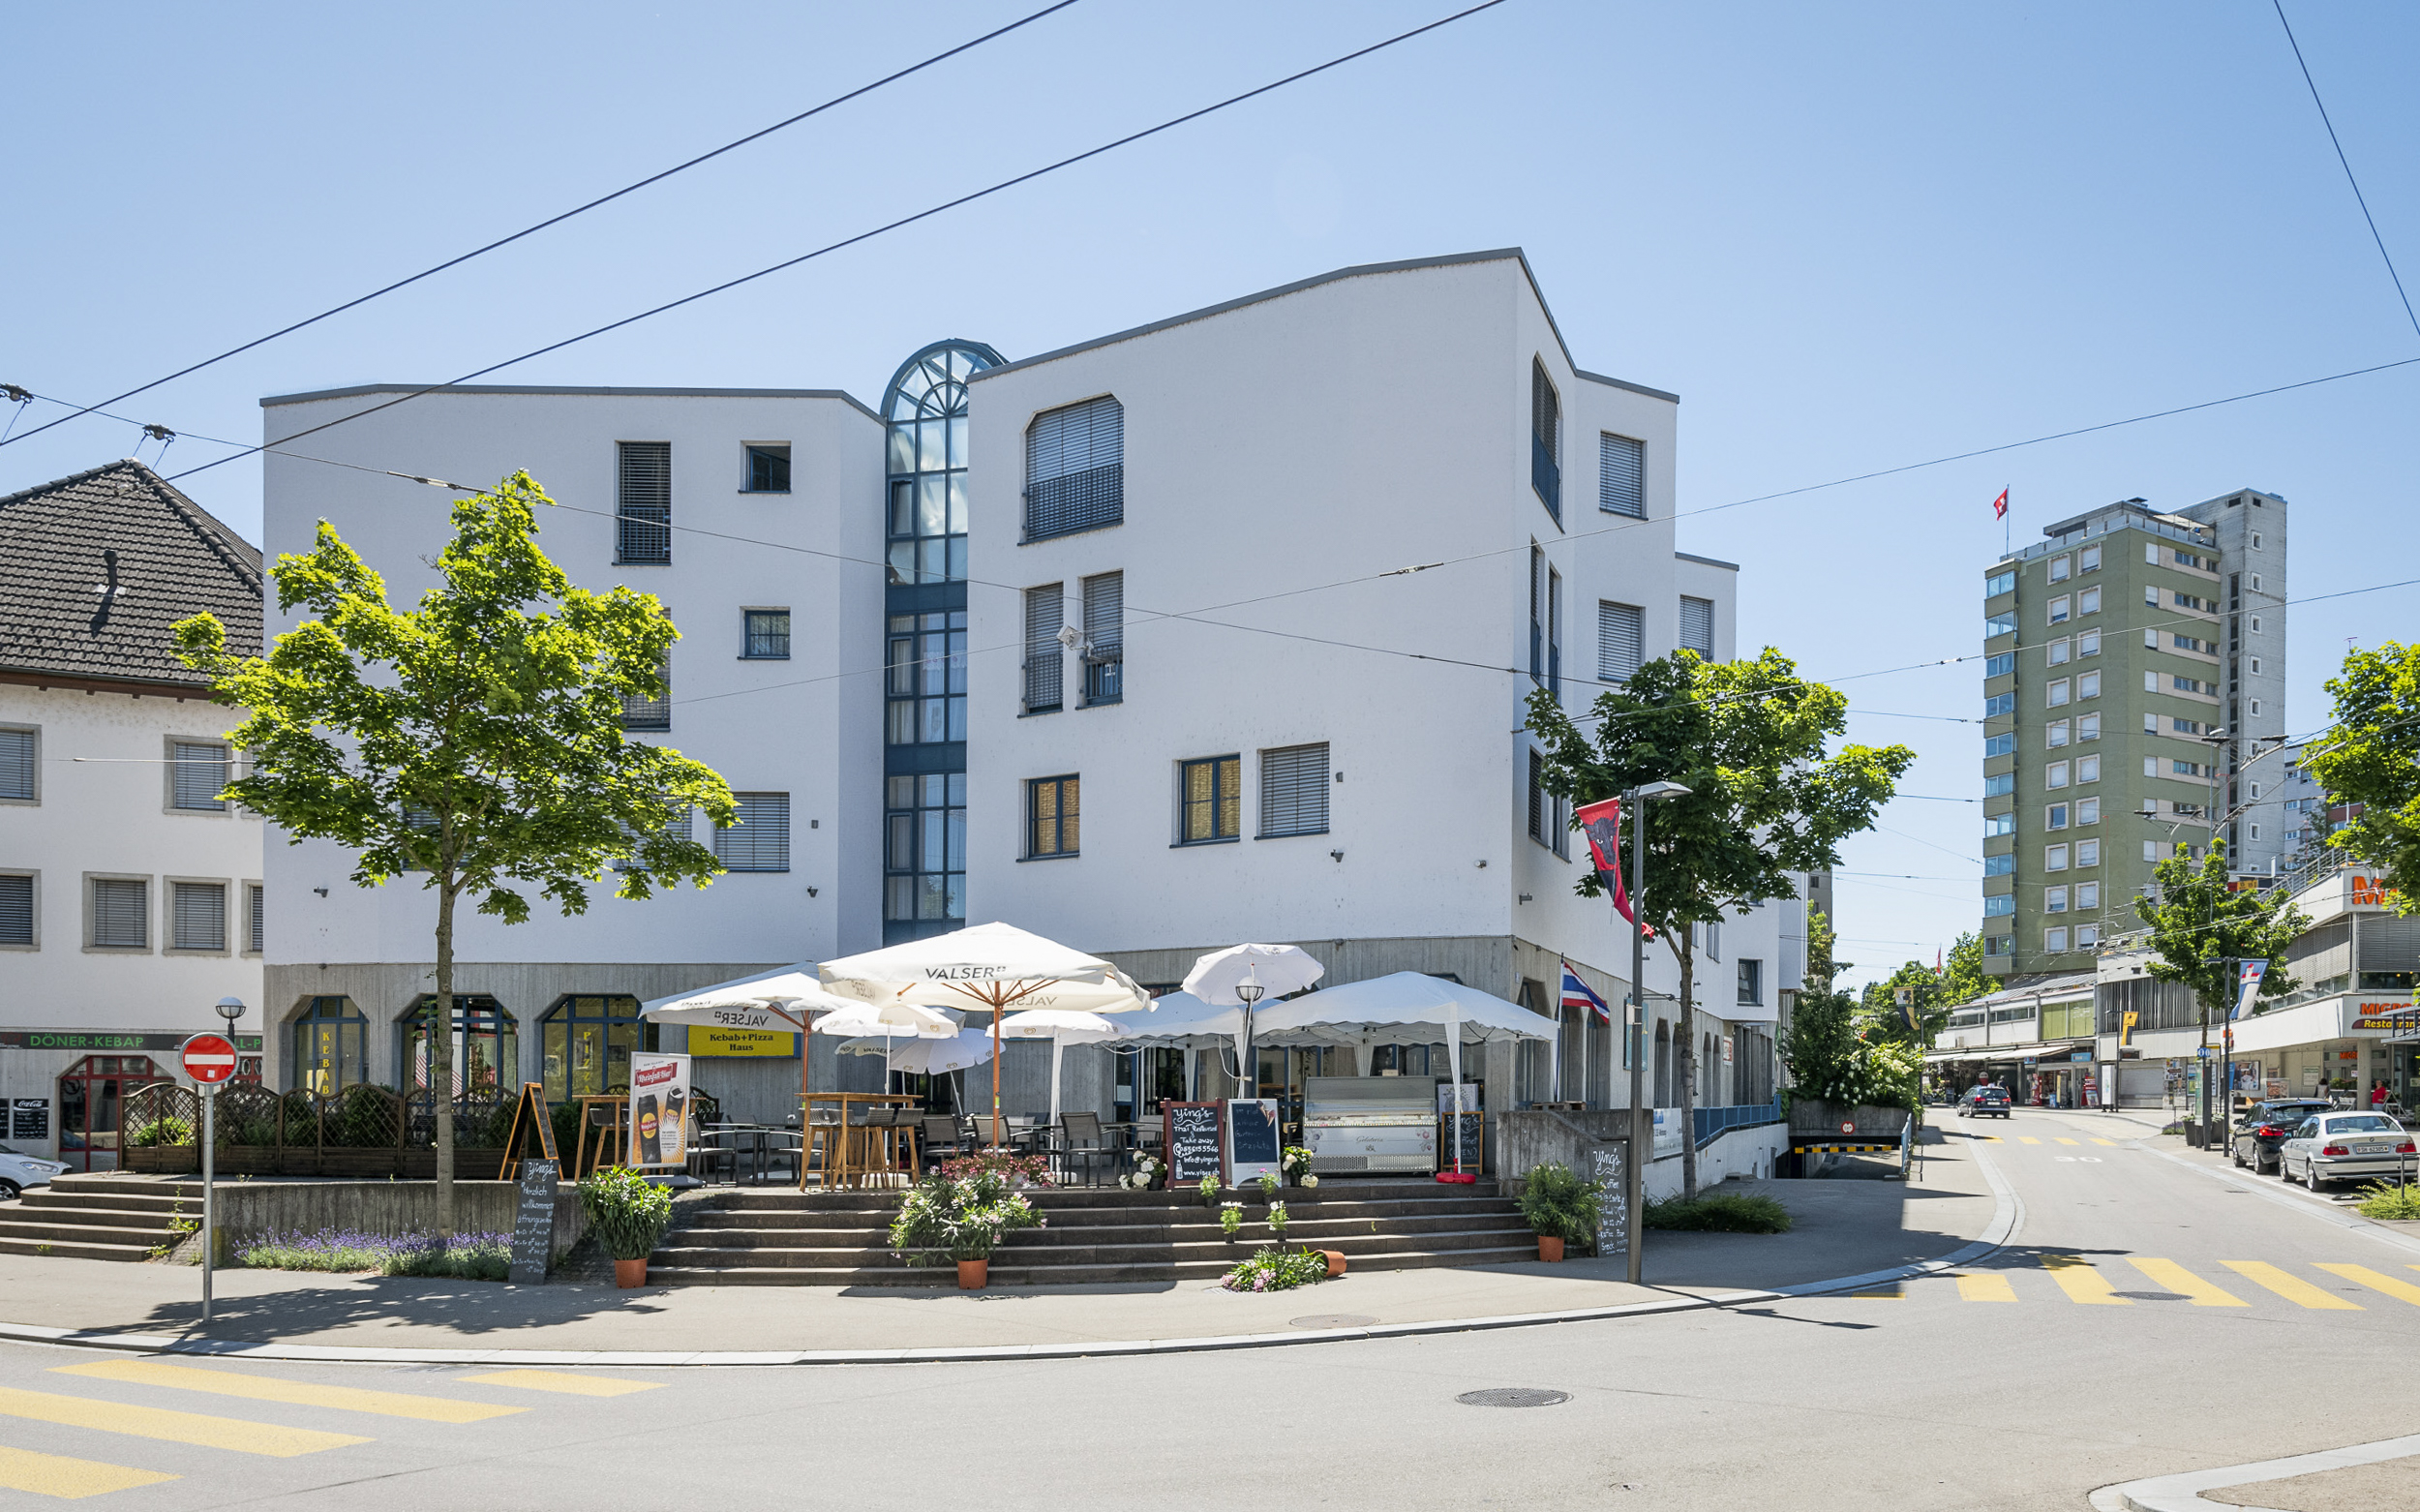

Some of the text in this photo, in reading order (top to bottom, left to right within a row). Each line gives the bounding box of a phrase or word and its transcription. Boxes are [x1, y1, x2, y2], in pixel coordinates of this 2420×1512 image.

[925, 967, 994, 980] VALSER
[30, 1033, 144, 1047] DÖNER-KEBAP
[583, 1032, 591, 1094] PIZZA
